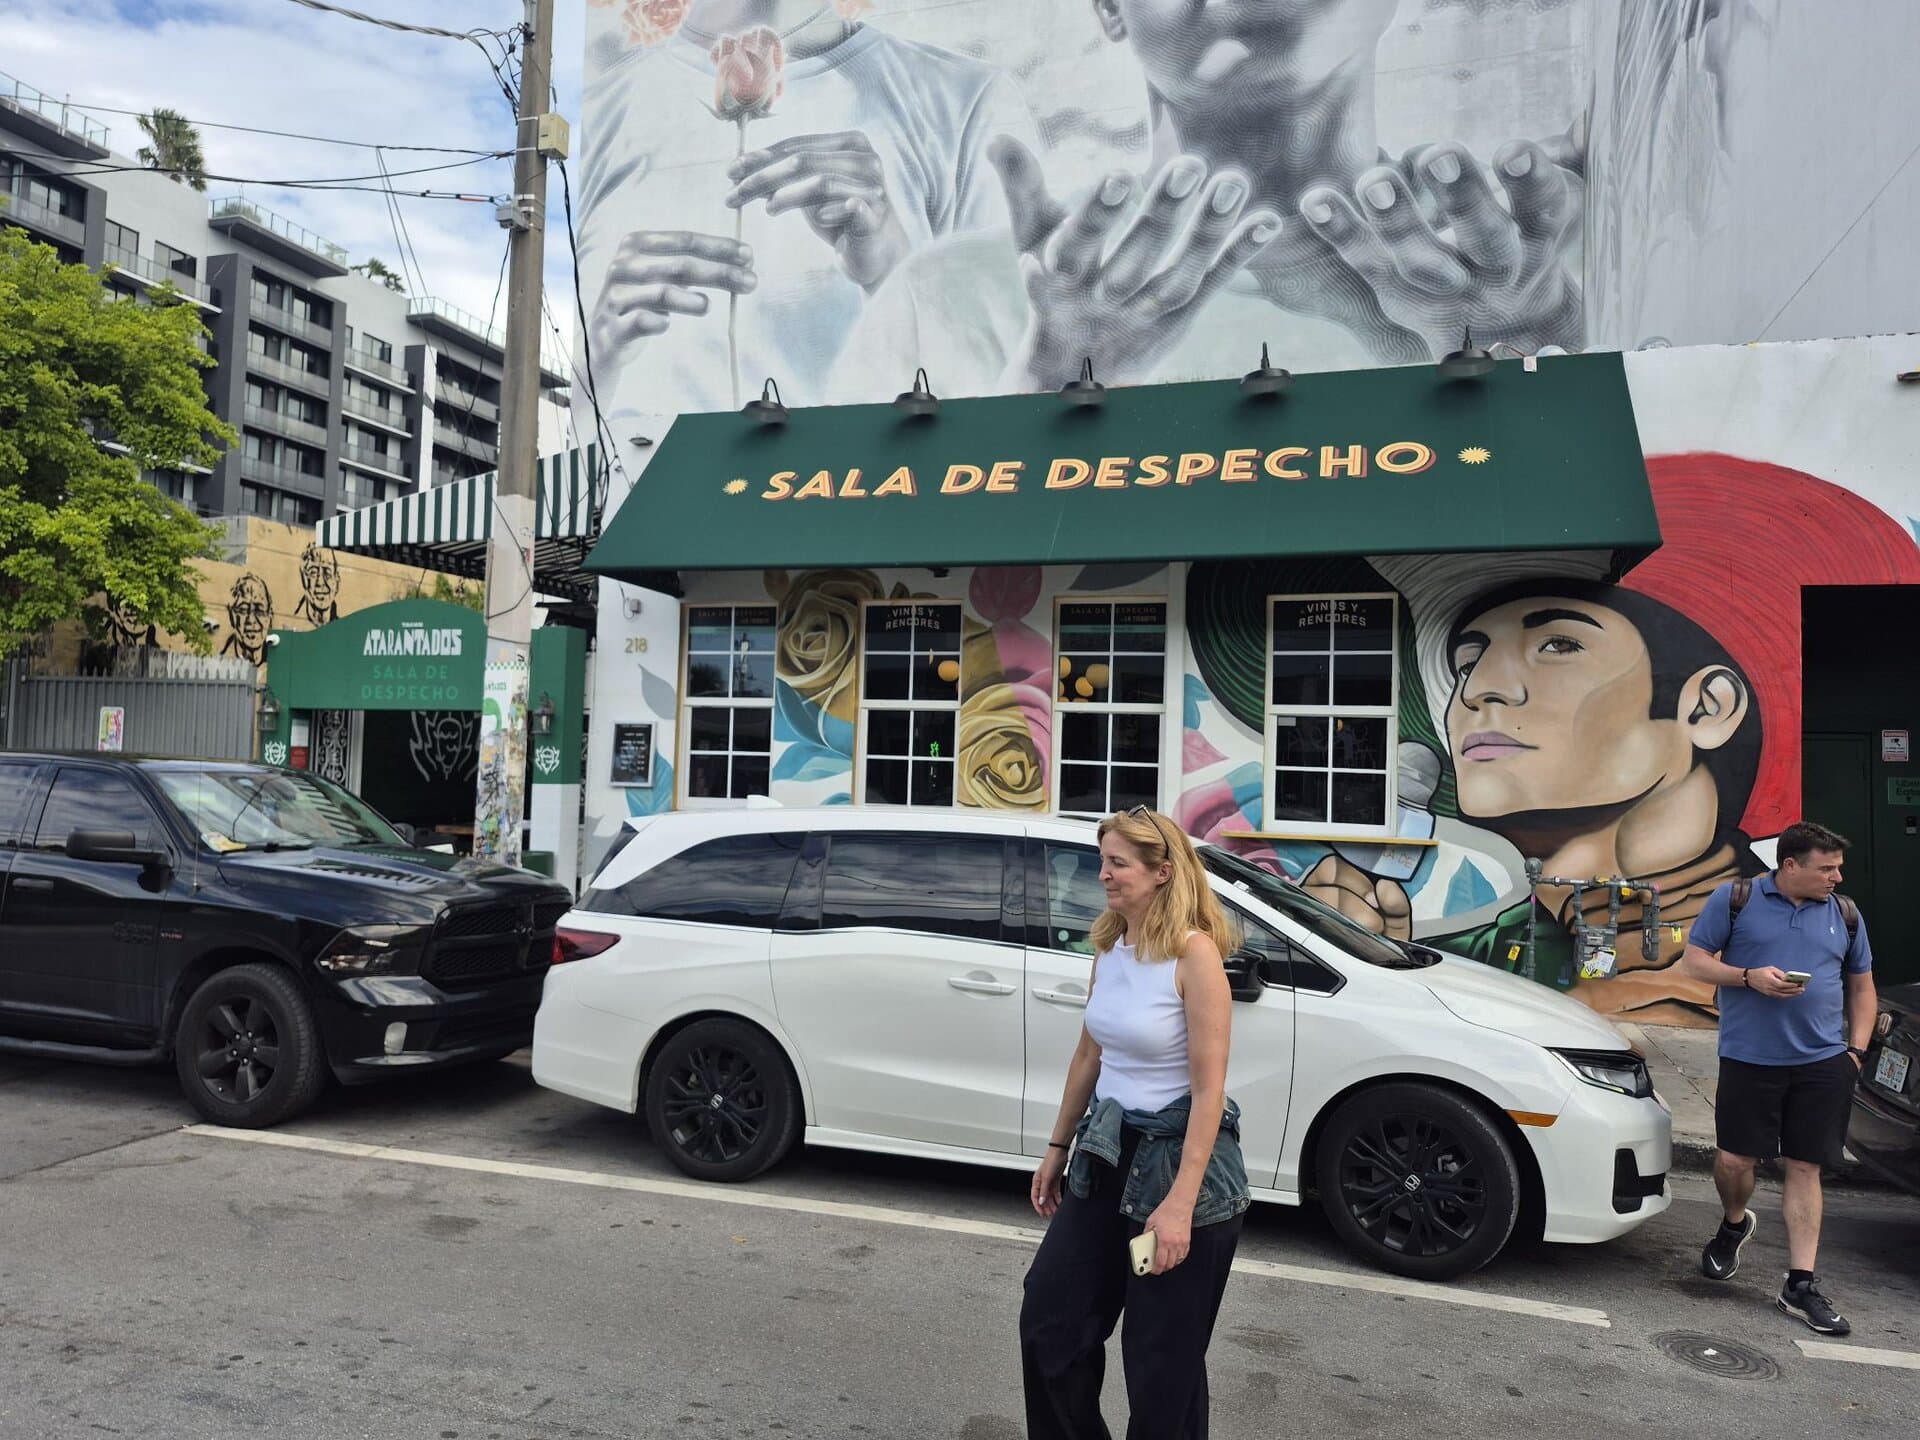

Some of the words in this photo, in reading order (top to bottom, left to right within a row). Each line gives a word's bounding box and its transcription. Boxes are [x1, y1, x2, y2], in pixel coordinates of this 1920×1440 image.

[762, 466, 918, 499] SALA
[940, 461, 1026, 495] DE
[1044, 441, 1437, 490] DESPECHO
[927, 607, 935, 617] Y
[1351, 602, 1359, 613] Y
[885, 617, 941, 631] RENCORES
[1298, 613, 1367, 628] RENCORES
[363, 628, 463, 656] ATARANTADOS
[624, 638, 648, 653] 218
[373, 664, 417, 680] SALA
[426, 664, 448, 680] DE
[361, 684, 459, 700] DESPECHO
